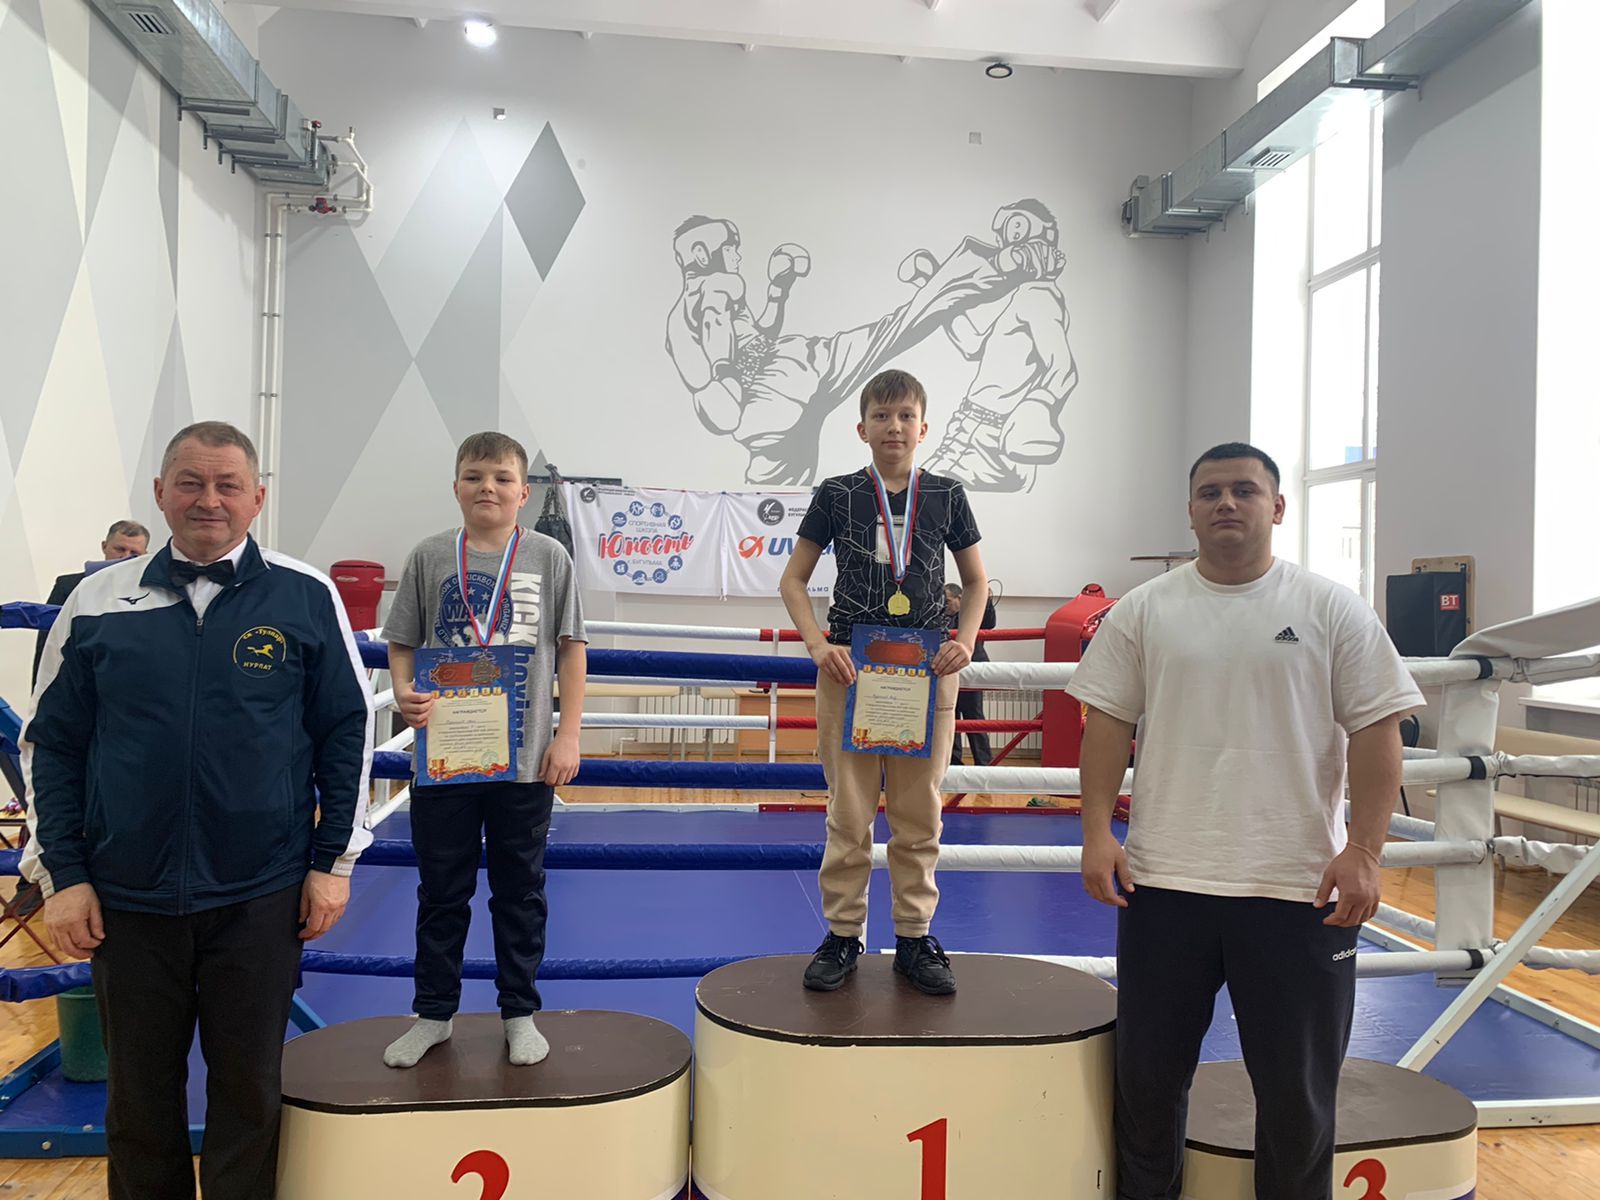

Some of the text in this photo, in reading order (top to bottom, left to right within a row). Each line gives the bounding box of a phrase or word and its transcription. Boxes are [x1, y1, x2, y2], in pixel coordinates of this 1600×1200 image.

[598, 531, 694, 559] Юность
[1441, 594, 1459, 606] BT
[243, 662, 272, 671] НУРЛАТ
[906, 1118, 948, 1200] 1
